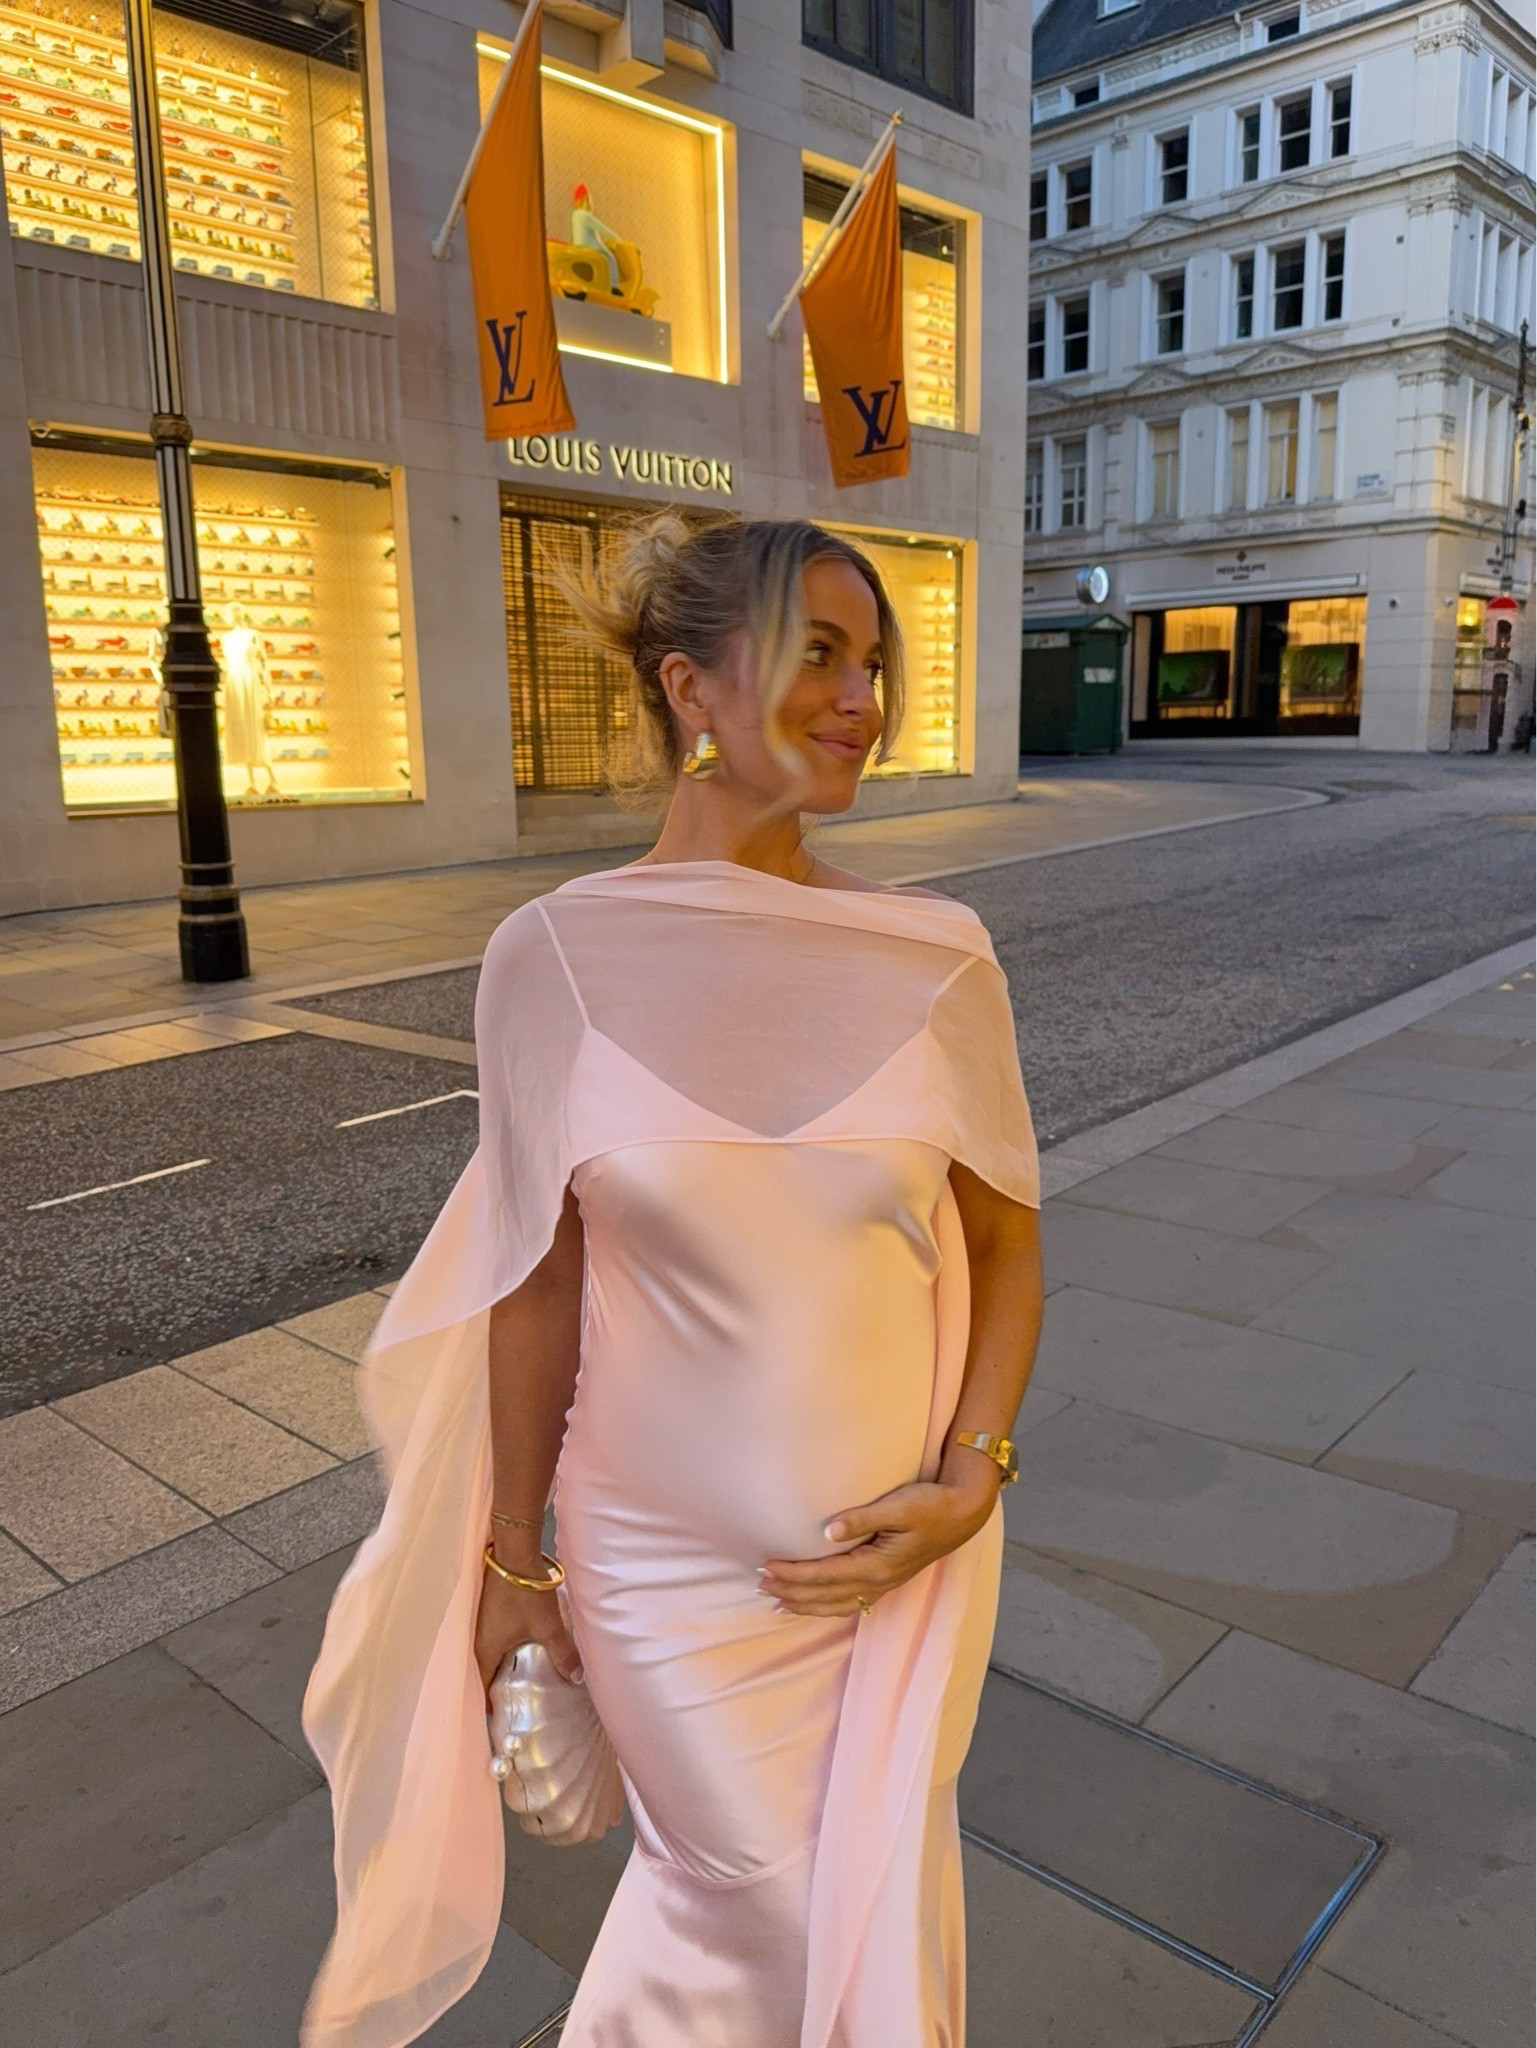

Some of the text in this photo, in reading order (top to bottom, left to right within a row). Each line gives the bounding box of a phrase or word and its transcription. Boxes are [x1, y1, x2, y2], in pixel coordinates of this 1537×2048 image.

[486, 310, 535, 406] LV
[842, 379, 906, 457] LV
[508, 435, 735, 495] LOUIS VUITTON
